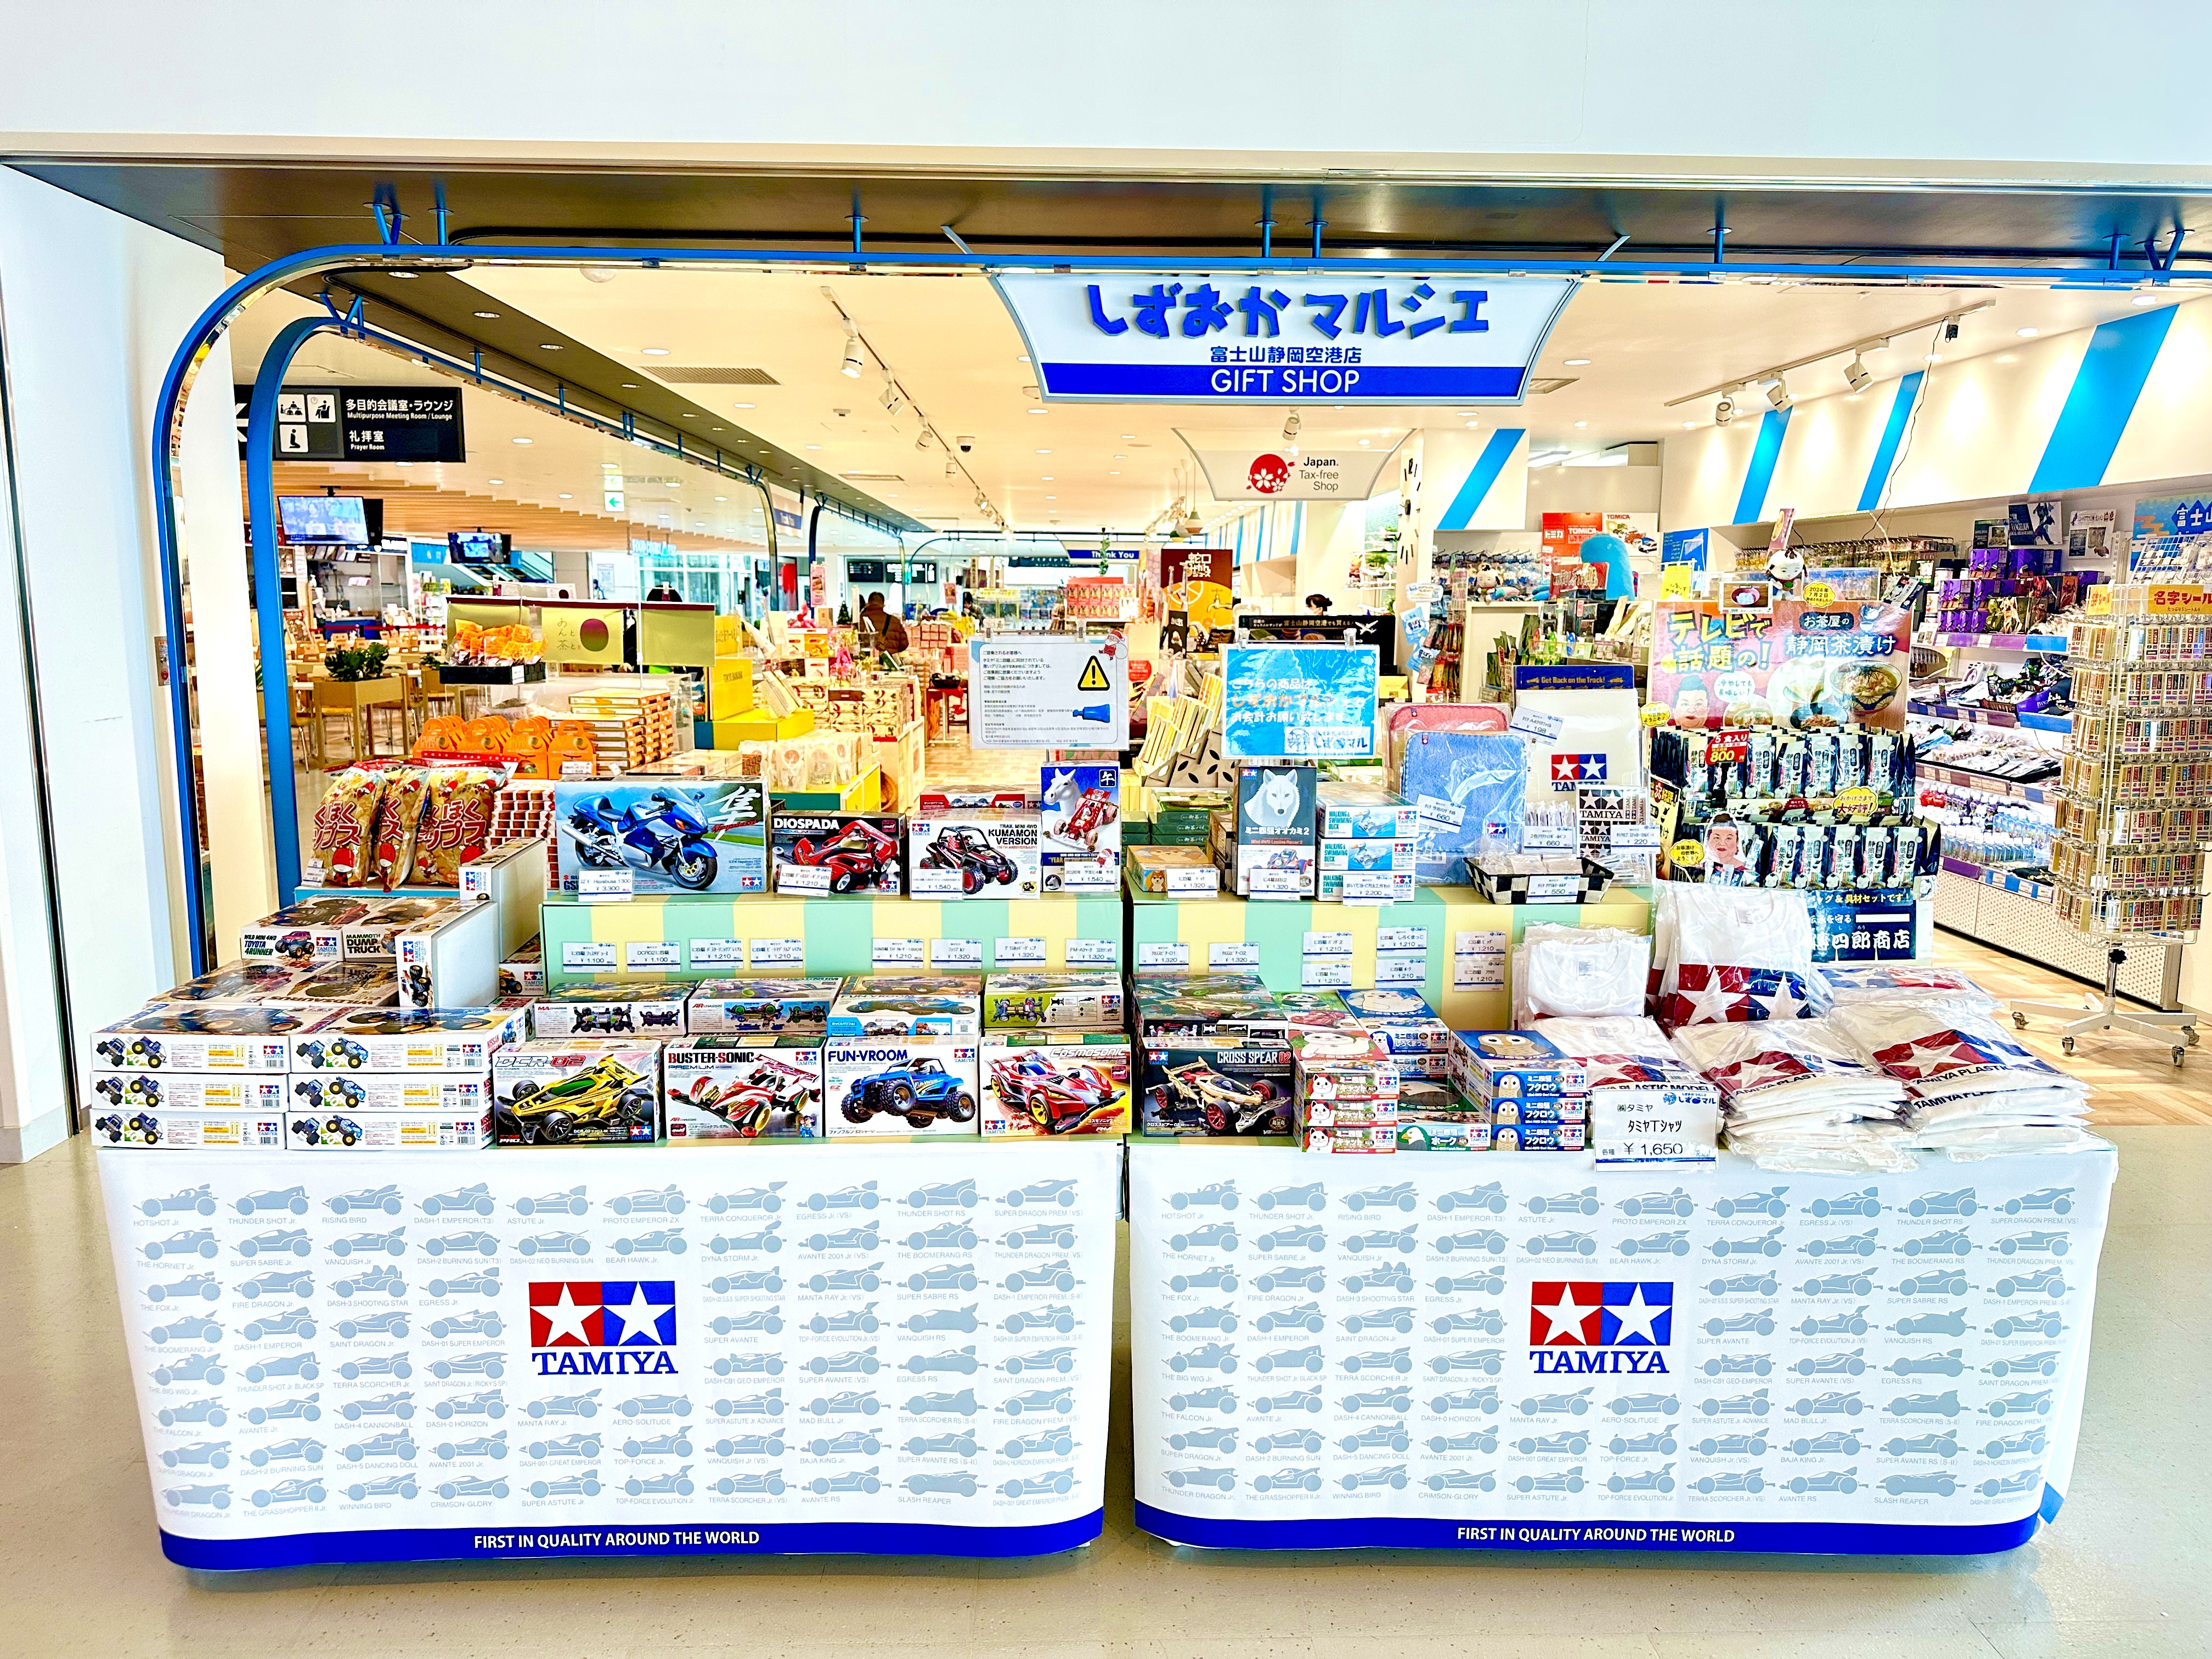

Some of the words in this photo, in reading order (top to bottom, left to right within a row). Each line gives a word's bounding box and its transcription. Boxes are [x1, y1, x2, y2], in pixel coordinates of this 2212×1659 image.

[1210, 346, 1361, 364] 富士山静岡空港店
[1210, 369, 1274, 394] GIFT
[1283, 370, 1359, 394] SHOP
[346, 399, 453, 412] 多目的会議室・ラウンジ
[347, 412, 385, 421] Multipurpose
[386, 413, 410, 421] Meeting
[431, 413, 453, 421] Lounge
[349, 430, 384, 443] 礼拝室
[1299, 469, 1339, 480] Tax-free
[1313, 481, 1339, 493] Shop
[1544, 531, 1564, 539] トミカ
[1091, 550, 1116, 559] Thnk
[1188, 552, 1211, 564] 蛇口
[2154, 590, 2212, 605] 名字シール
[1803, 614, 1850, 629] お茶屋の
[1669, 612, 1771, 645] テレビで
[1786, 634, 1897, 655] 静岡茶漬け
[1710, 751, 1735, 761] 800
[1579, 810, 1623, 819] TAMIYA
[774, 818, 839, 830] DIOSPADA
[988, 829, 1037, 837] KUMAMON
[996, 837, 1037, 845] VERSION
[245, 948, 274, 956] 4RUNNER
[352, 946, 381, 954] TRUCK
[668, 1052, 754, 1064] BUSTER-SONIC
[828, 1049, 908, 1062] FUN-VROOM
[1217, 1052, 1245, 1064] CROSS
[1248, 1052, 1277, 1064] SPEAR
[1279, 1051, 1291, 1064] 02
[495, 1056, 586, 1068] DCR-02
[1340, 1084, 1367, 1093] キャット
[1526, 1083, 1557, 1092] フクロウ
[1525, 1110, 1555, 1118] フクロウ
[1431, 1137, 1457, 1146] ホーク
[1525, 1137, 1554, 1146] フクロウ
[1624, 1142, 1634, 1155] ¥
[1641, 1143, 1683, 1156] 1,650
[532, 1351, 679, 1375] TAMIYA
[1530, 1350, 1670, 1374] TAMIYA
[922, 1497, 951, 1505] REAPER
[474, 1535, 515, 1549] FIRST
[518, 1534, 533, 1547] IN
[536, 1533, 602, 1548] QUALITY
[605, 1532, 670, 1546] AROUND
[674, 1532, 702, 1544] THE
[705, 1531, 760, 1544] WORLD
[1457, 1527, 1497, 1539] FIRST
[1500, 1528, 1515, 1540] IN
[1519, 1528, 1581, 1543] QUALITY
[1583, 1528, 1647, 1541] AROUND
[1650, 1529, 1677, 1541] THE
[1680, 1530, 1735, 1542] WORLD
